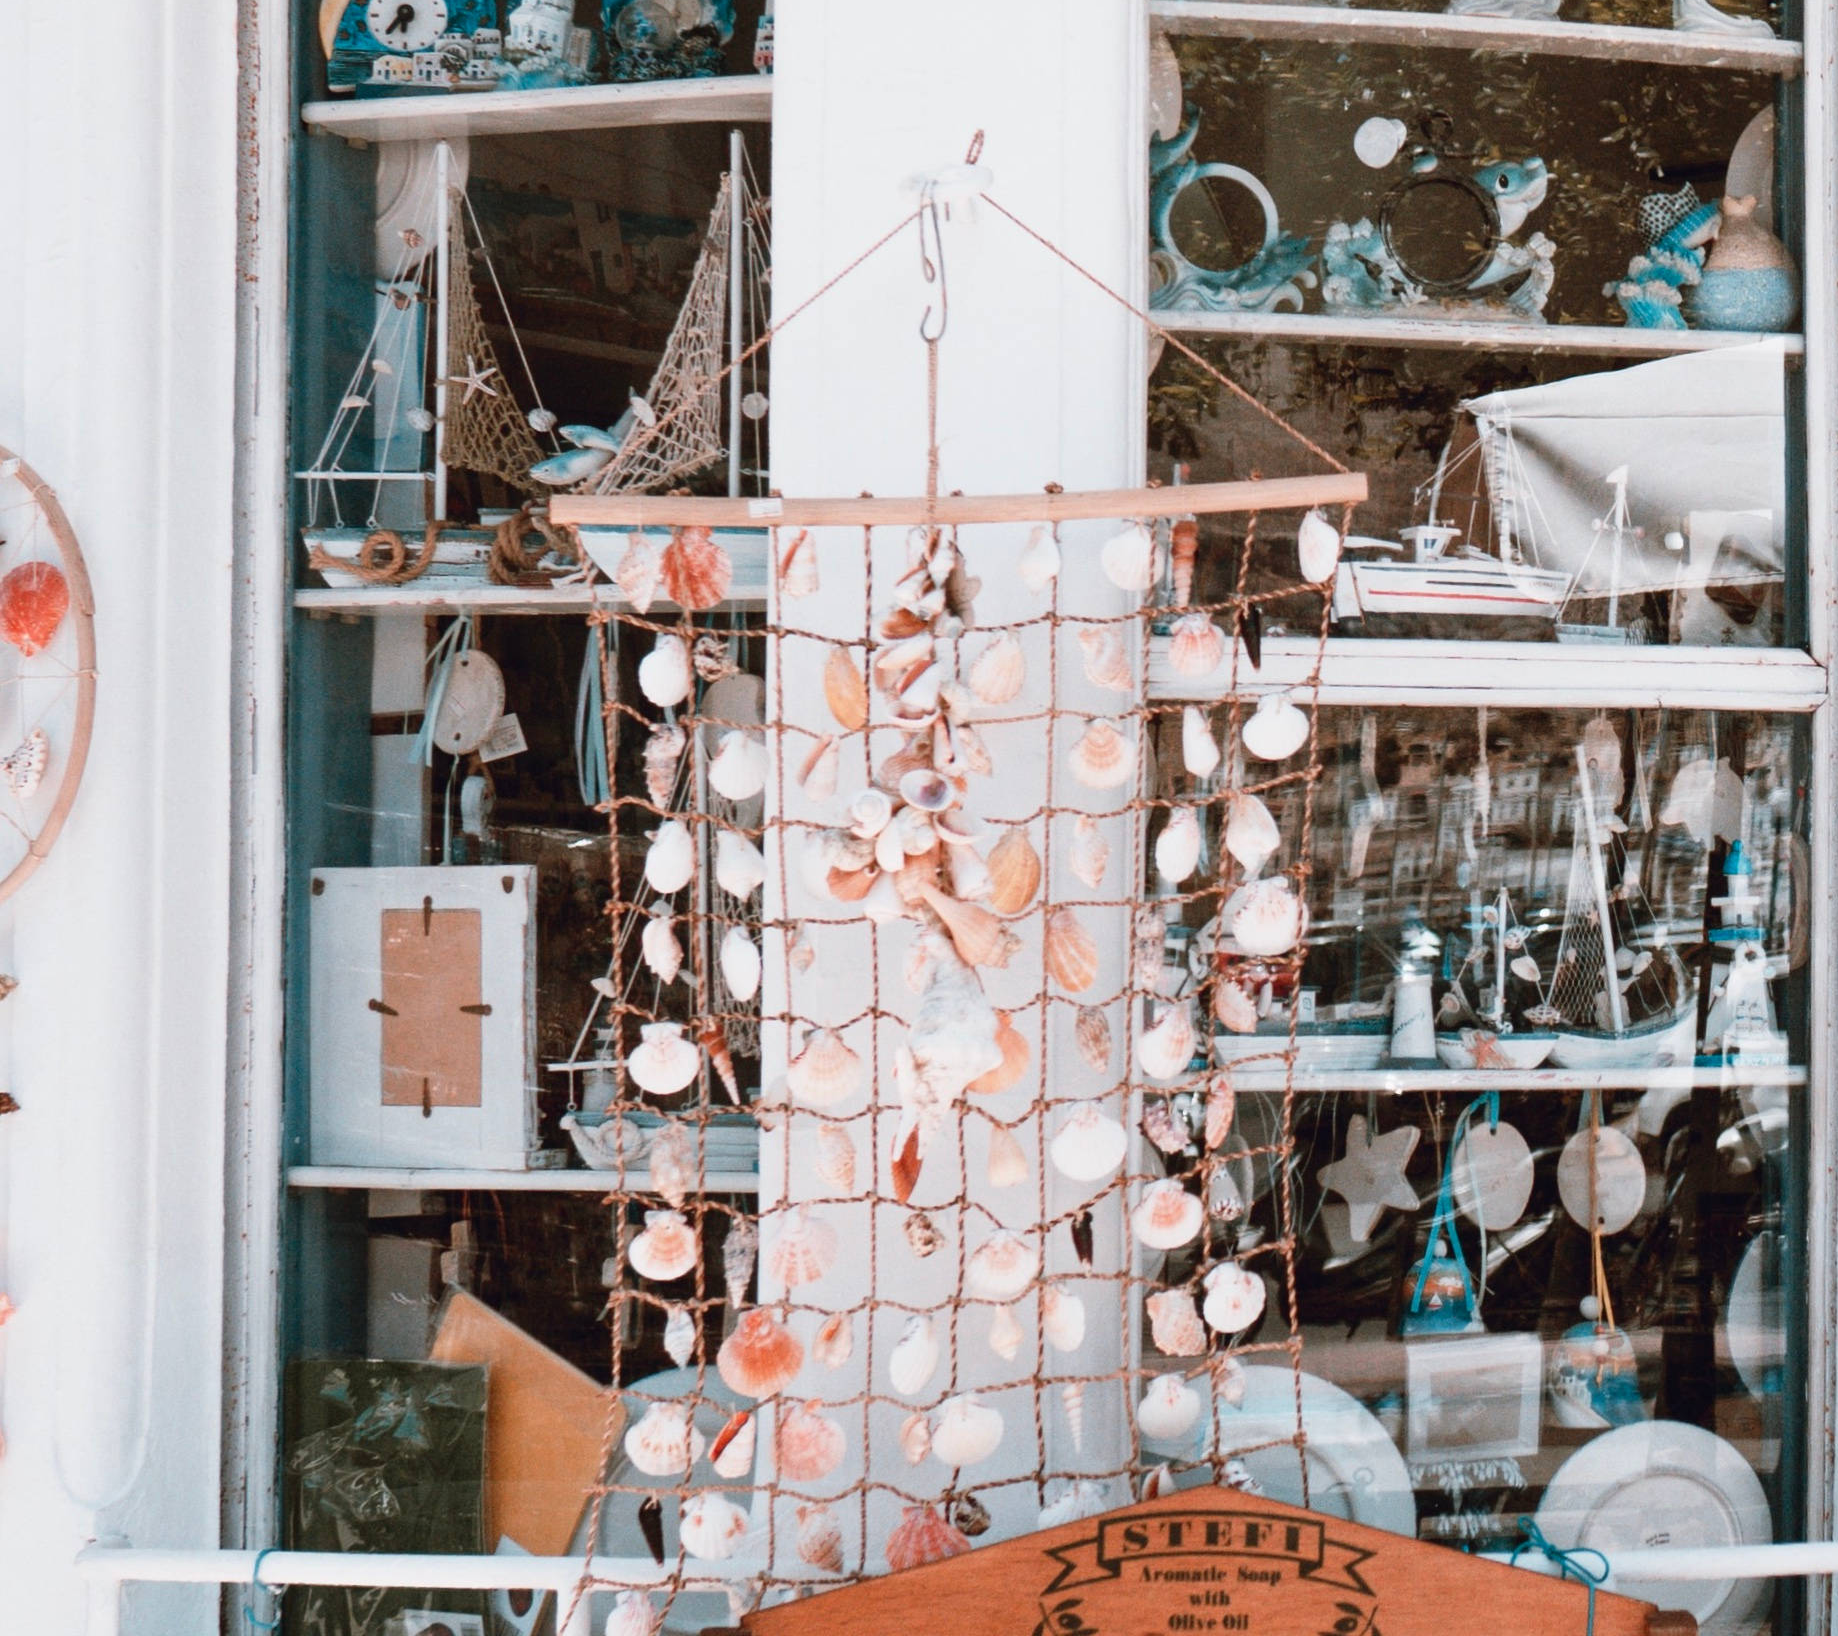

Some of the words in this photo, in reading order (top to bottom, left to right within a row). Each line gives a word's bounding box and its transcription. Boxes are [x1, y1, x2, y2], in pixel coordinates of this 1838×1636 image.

[1121, 1521, 1300, 1554] STEFI
[1138, 1566, 1228, 1584] Aromatic
[1236, 1566, 1282, 1587] Soap
[1189, 1590, 1231, 1607] with
[1168, 1614, 1217, 1631] Olive
[1223, 1613, 1250, 1631] Oil
